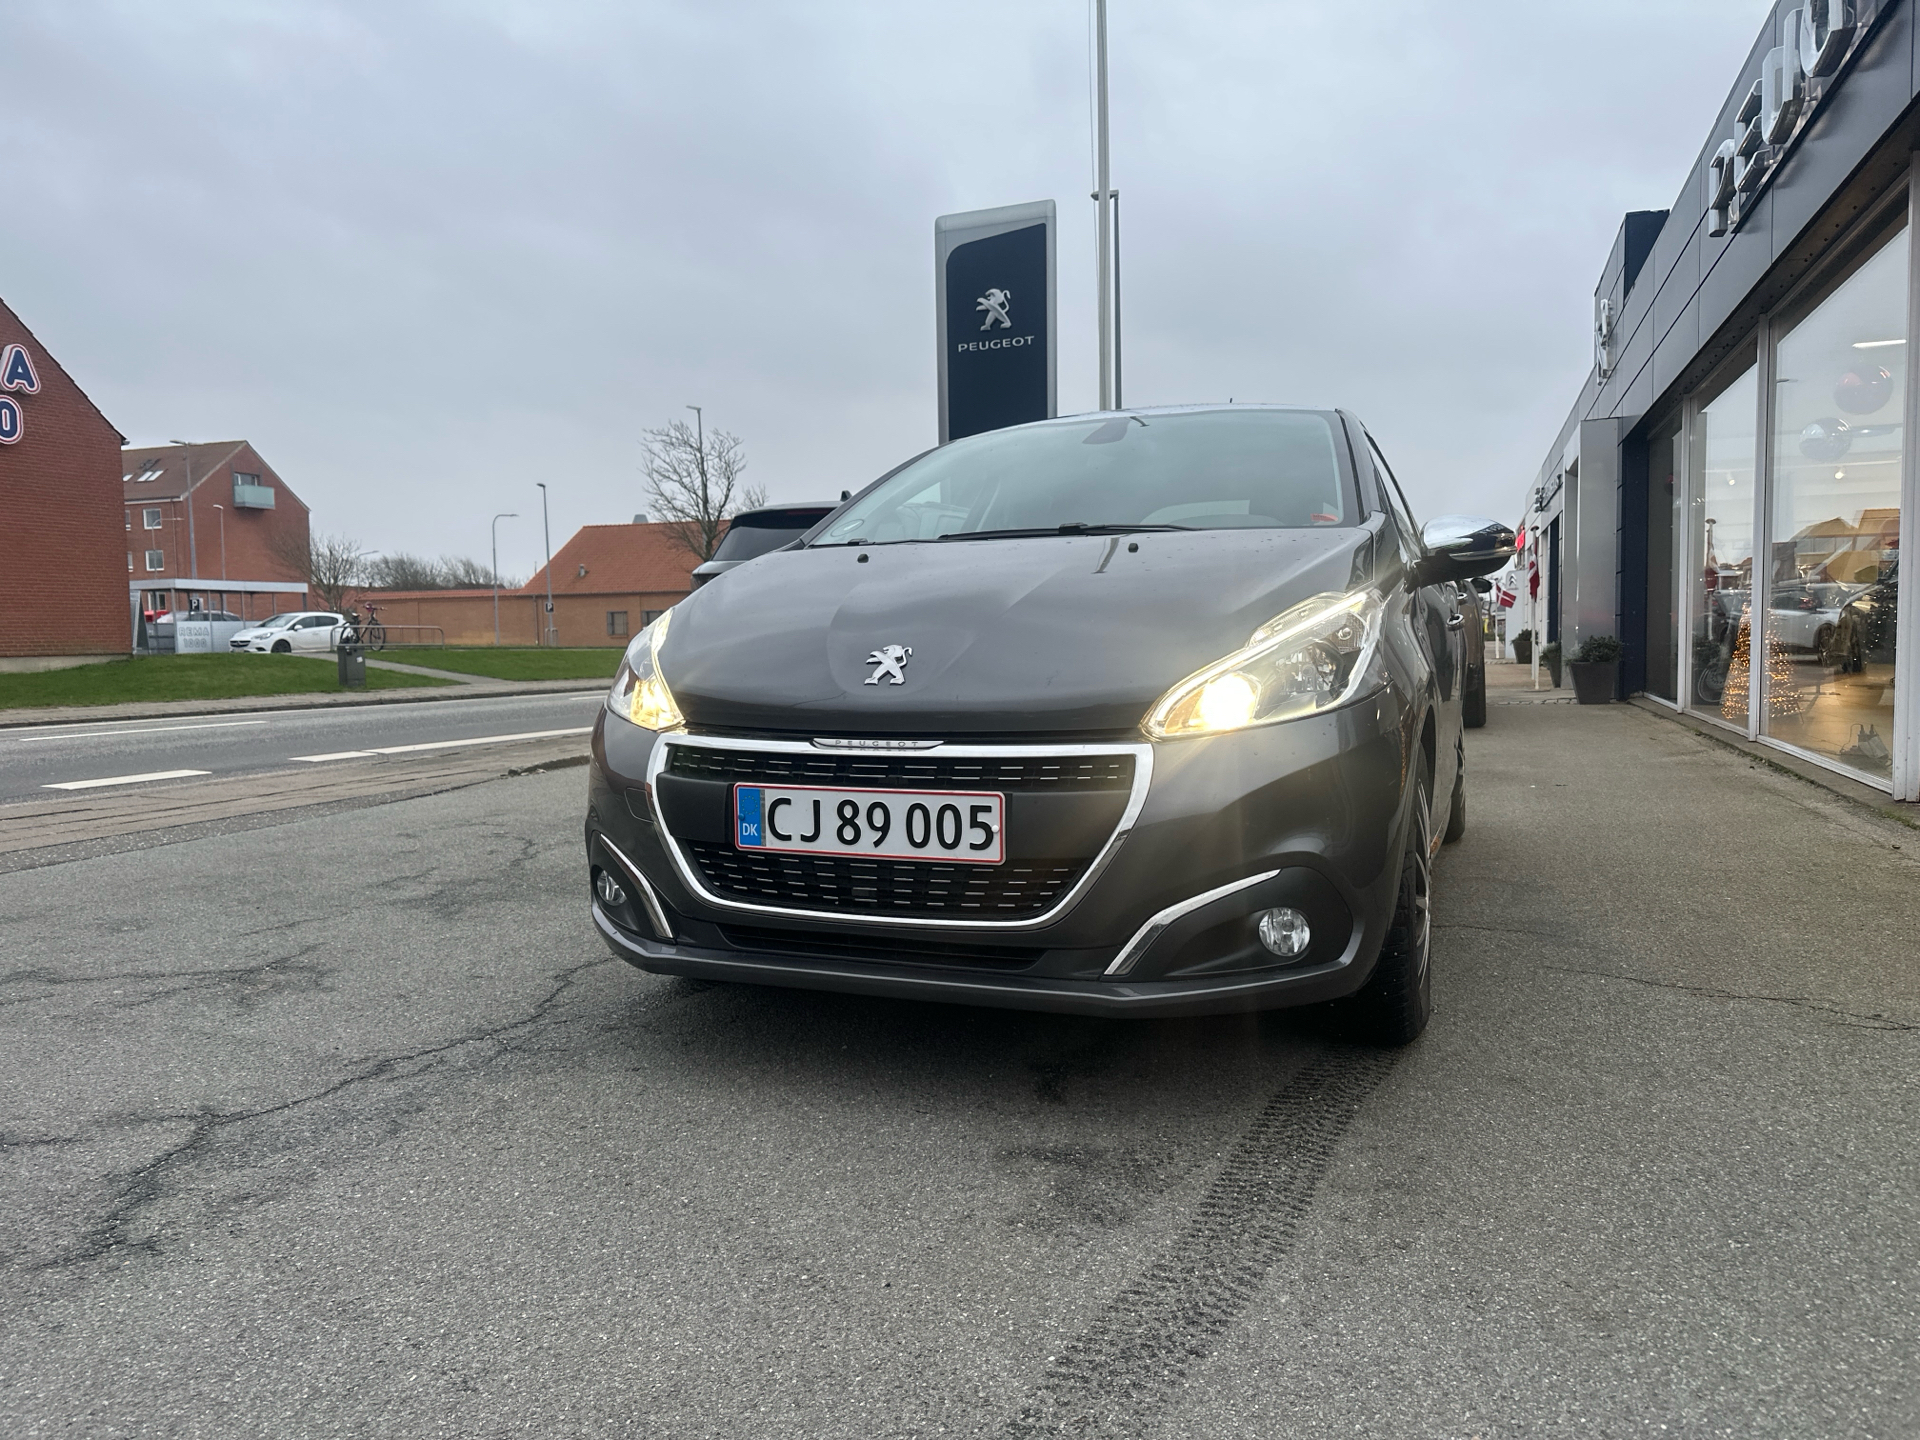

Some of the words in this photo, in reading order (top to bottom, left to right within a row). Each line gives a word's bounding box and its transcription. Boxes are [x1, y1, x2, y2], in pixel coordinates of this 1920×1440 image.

[958, 335, 1035, 353] PEUGEOT
[178, 626, 210, 637] REMA
[835, 740, 919, 748] PEUGEOT
[742, 823, 758, 837] DK
[767, 797, 821, 843] CJ
[836, 799, 891, 848] 89
[906, 802, 994, 851] 005
